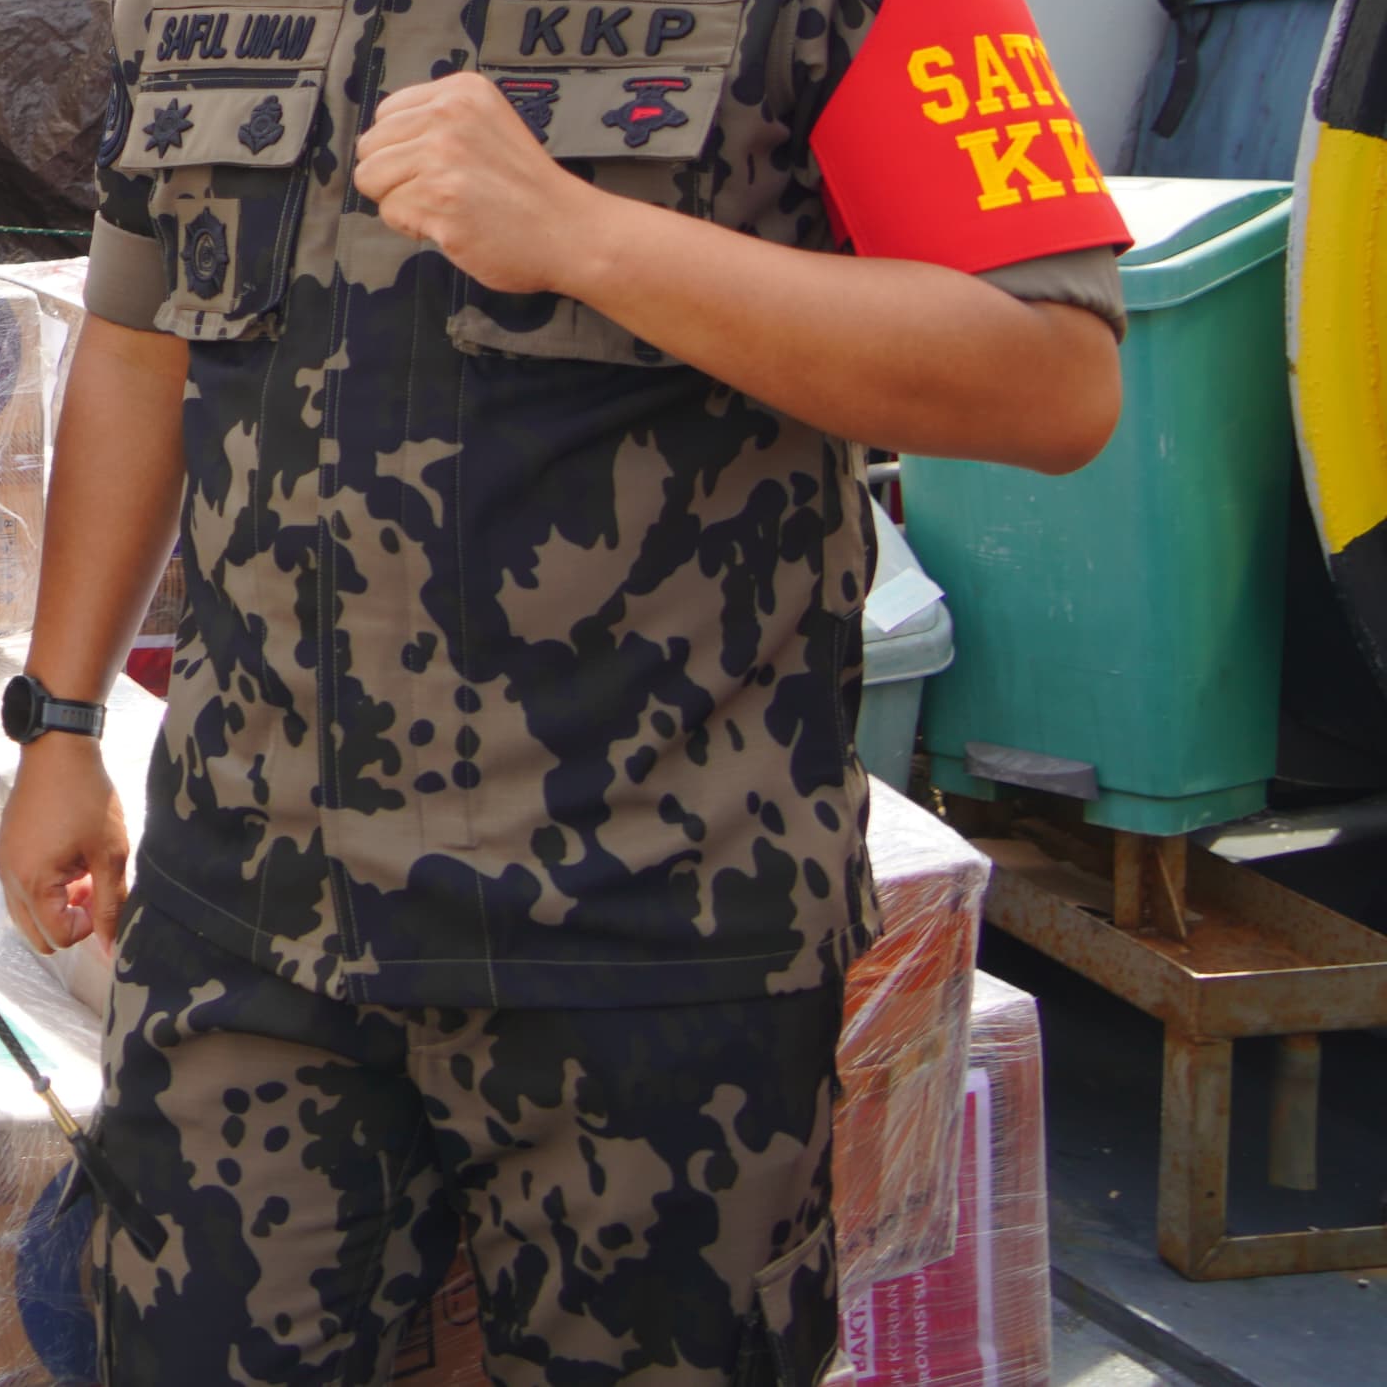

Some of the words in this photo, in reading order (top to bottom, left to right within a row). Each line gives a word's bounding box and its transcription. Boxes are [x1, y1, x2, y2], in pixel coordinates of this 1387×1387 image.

[156, 12, 230, 62] SAIFUL
[234, 12, 317, 62] UMAM
[519, 5, 697, 57] KKP
[913, 1304, 932, 1387] ROVINSI
